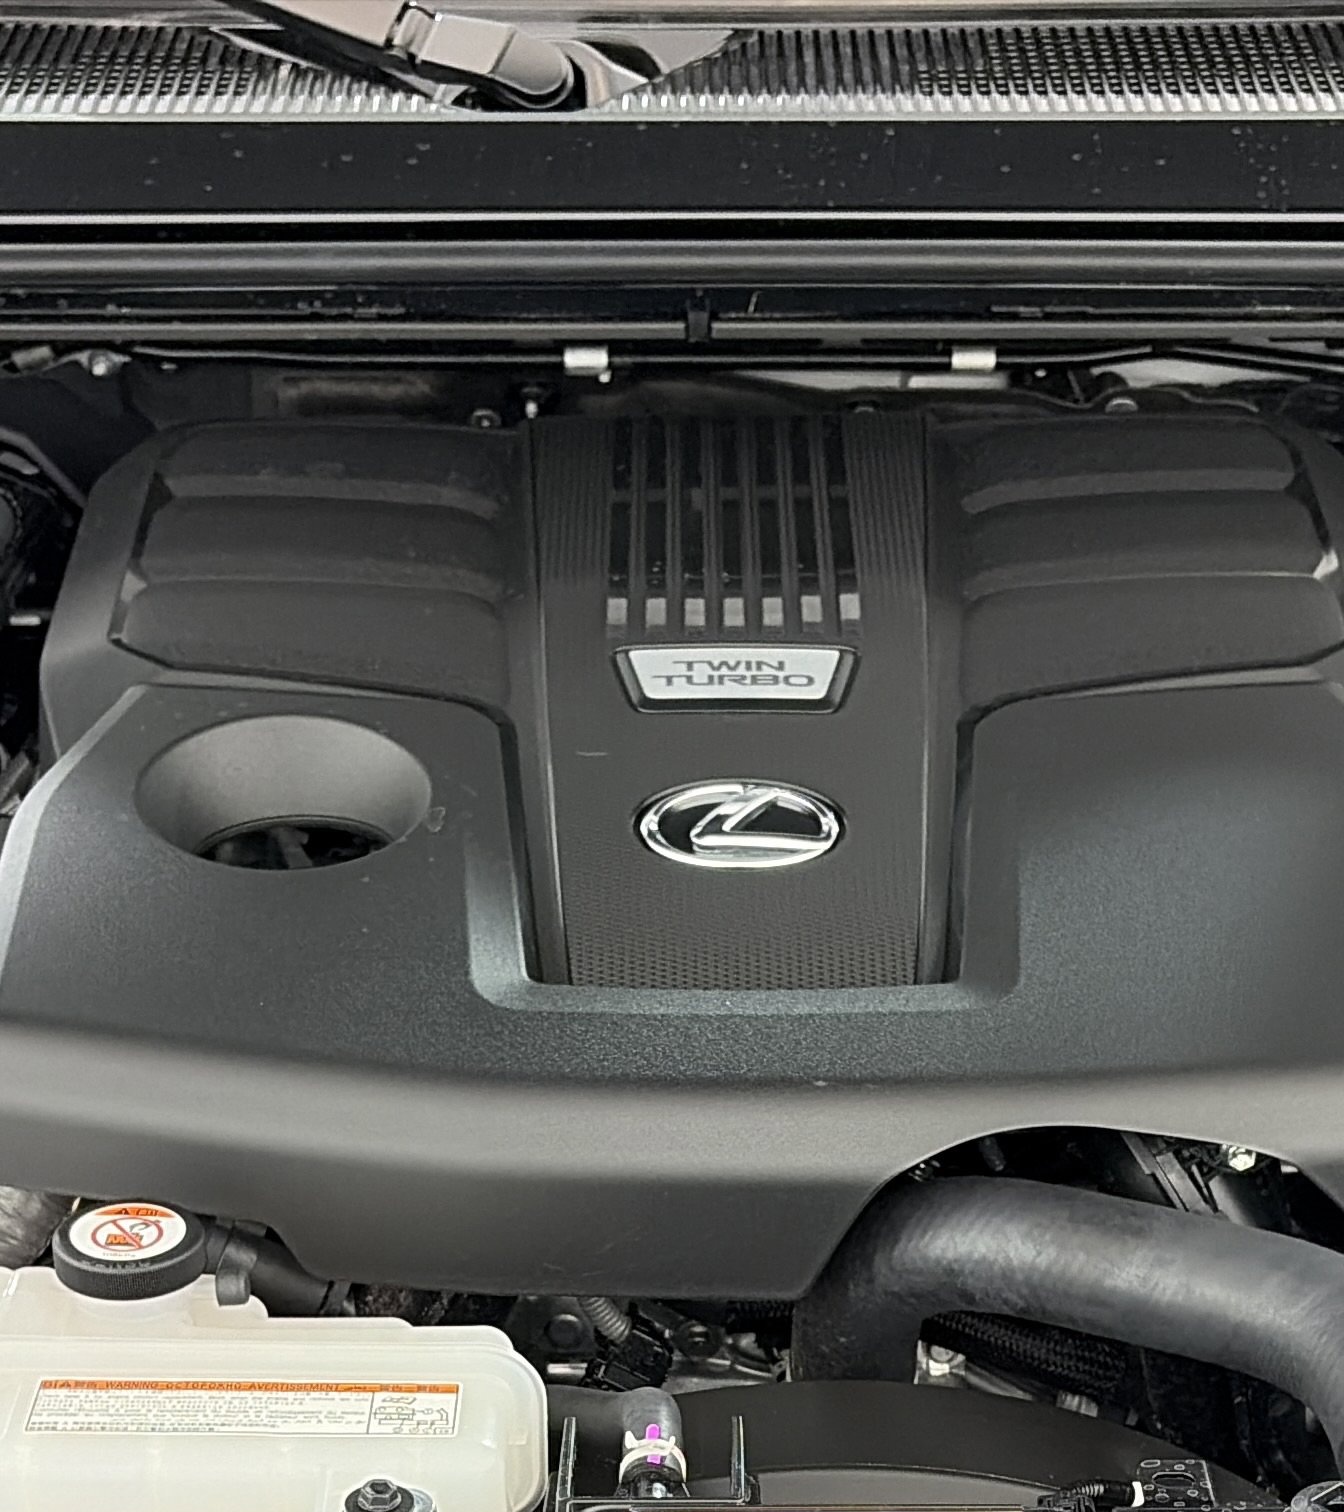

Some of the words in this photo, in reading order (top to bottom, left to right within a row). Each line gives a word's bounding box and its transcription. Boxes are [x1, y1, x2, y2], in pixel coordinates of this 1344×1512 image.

[672, 660, 786, 673] TWIN
[651, 674, 816, 688] TURBO
[105, 1380, 157, 1390] WARNING
[248, 1382, 340, 1392] AVERTISSEMENT
